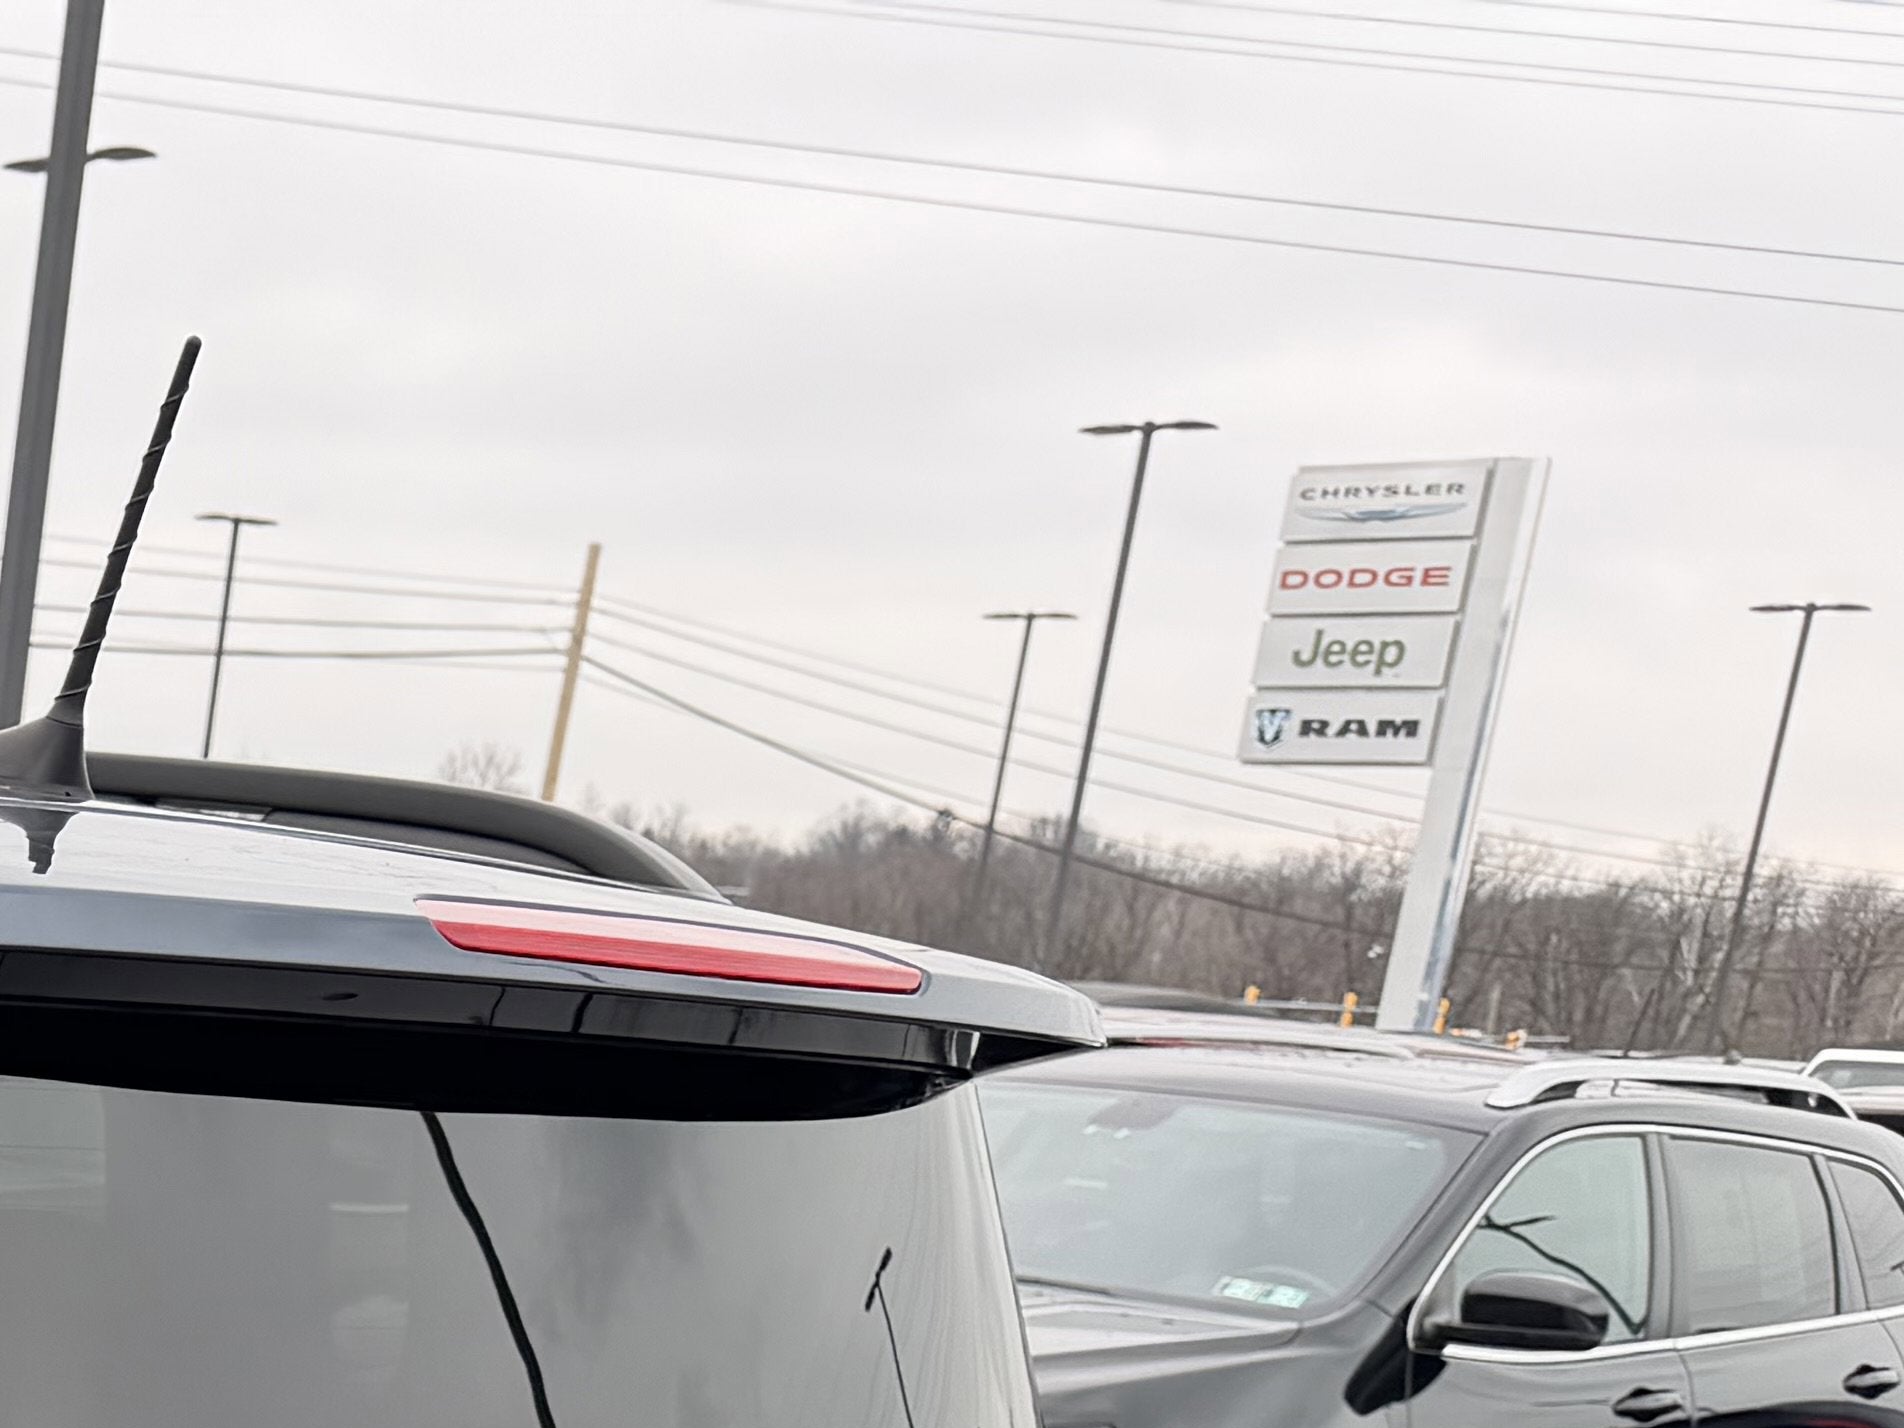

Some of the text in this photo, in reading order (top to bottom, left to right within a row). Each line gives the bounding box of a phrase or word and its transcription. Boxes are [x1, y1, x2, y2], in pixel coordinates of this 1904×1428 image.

[1299, 483, 1465, 500] CHRYSLER
[1280, 566, 1452, 590] DODGE
[1293, 628, 1406, 676] Jeep
[1298, 718, 1420, 738] RAM
